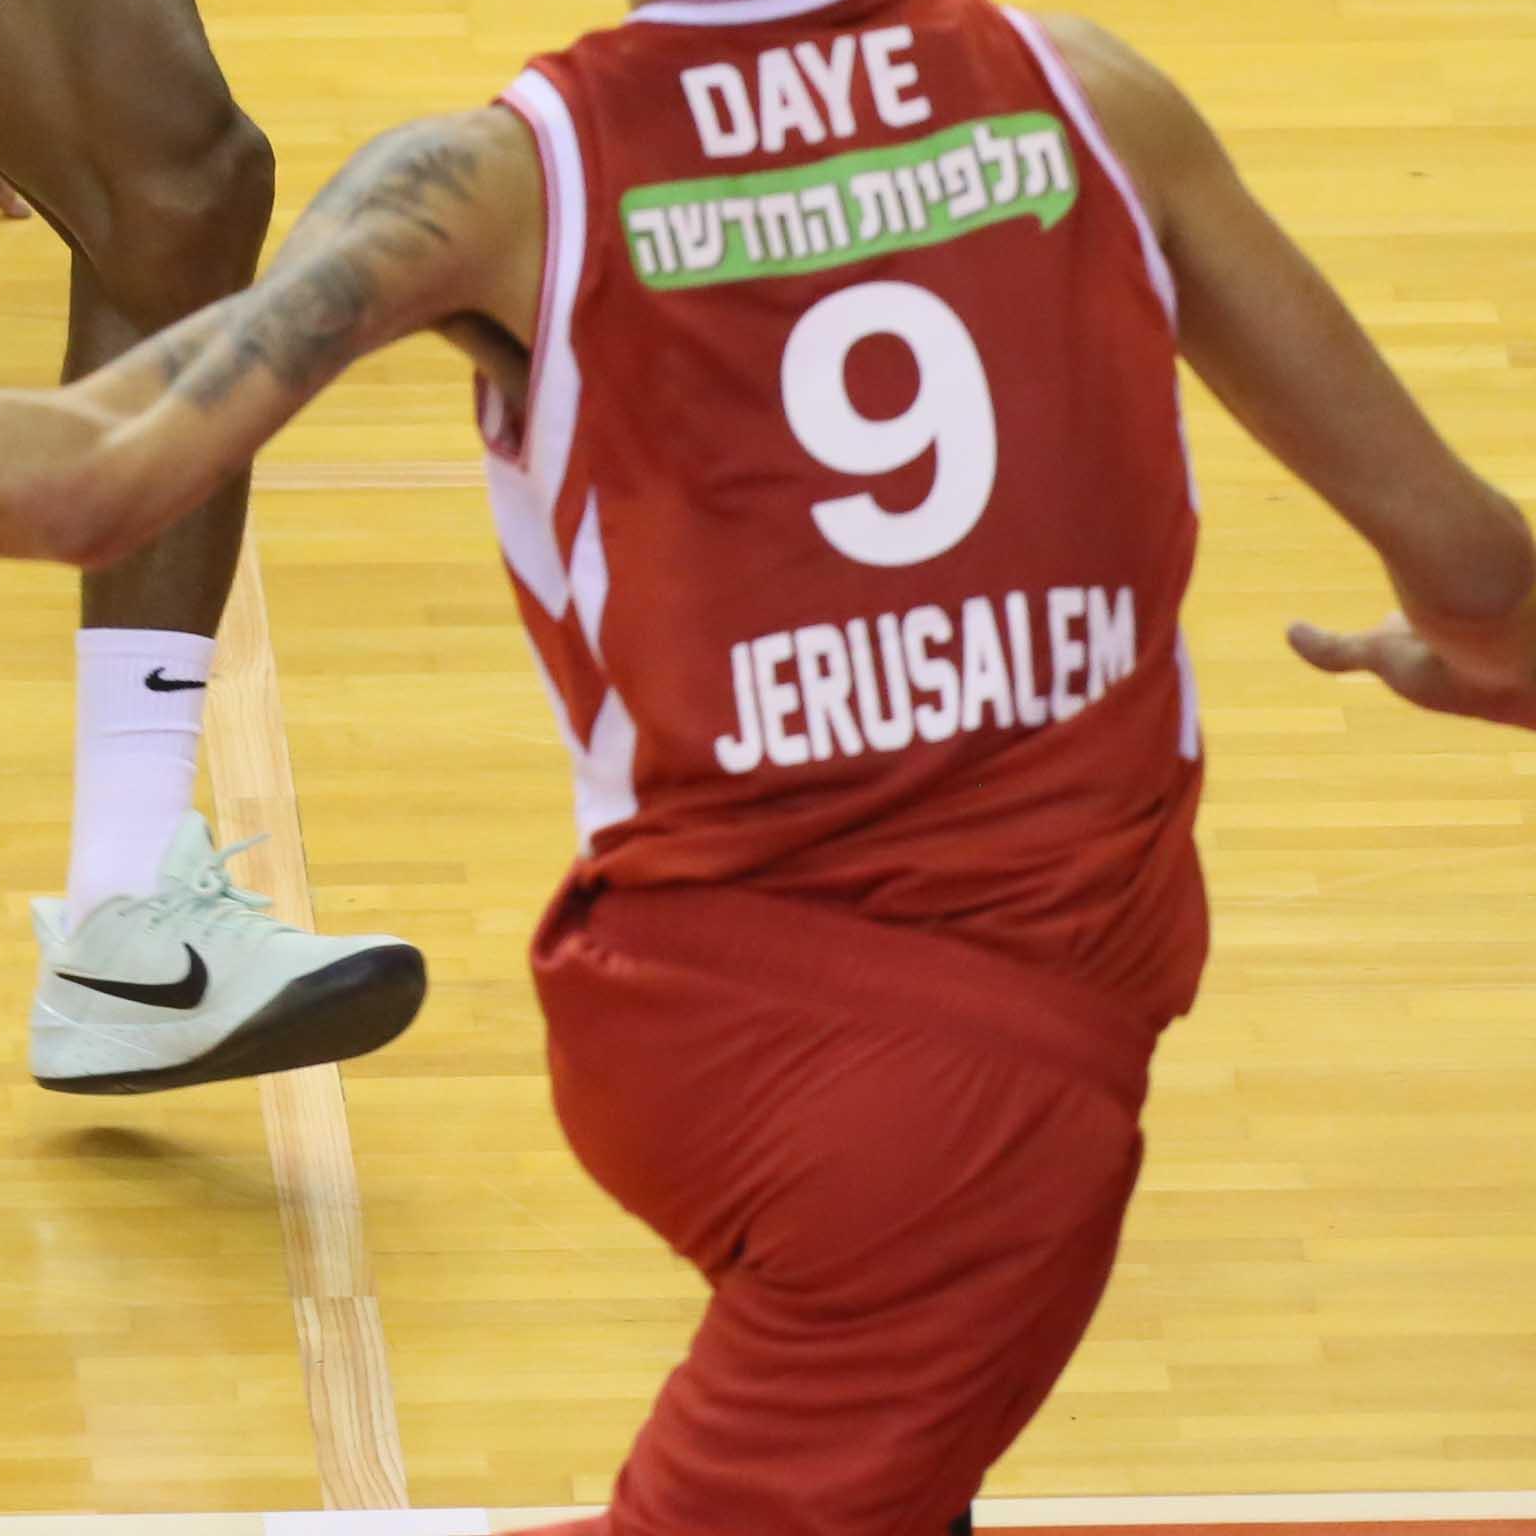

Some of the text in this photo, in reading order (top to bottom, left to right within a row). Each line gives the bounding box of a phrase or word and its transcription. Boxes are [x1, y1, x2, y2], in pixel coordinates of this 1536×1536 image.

[679, 25, 932, 159] DAYE
[627, 124, 1072, 275] תלפיות החדשה
[780, 280, 997, 567] 9
[714, 585, 1136, 774] JERUSALEM
